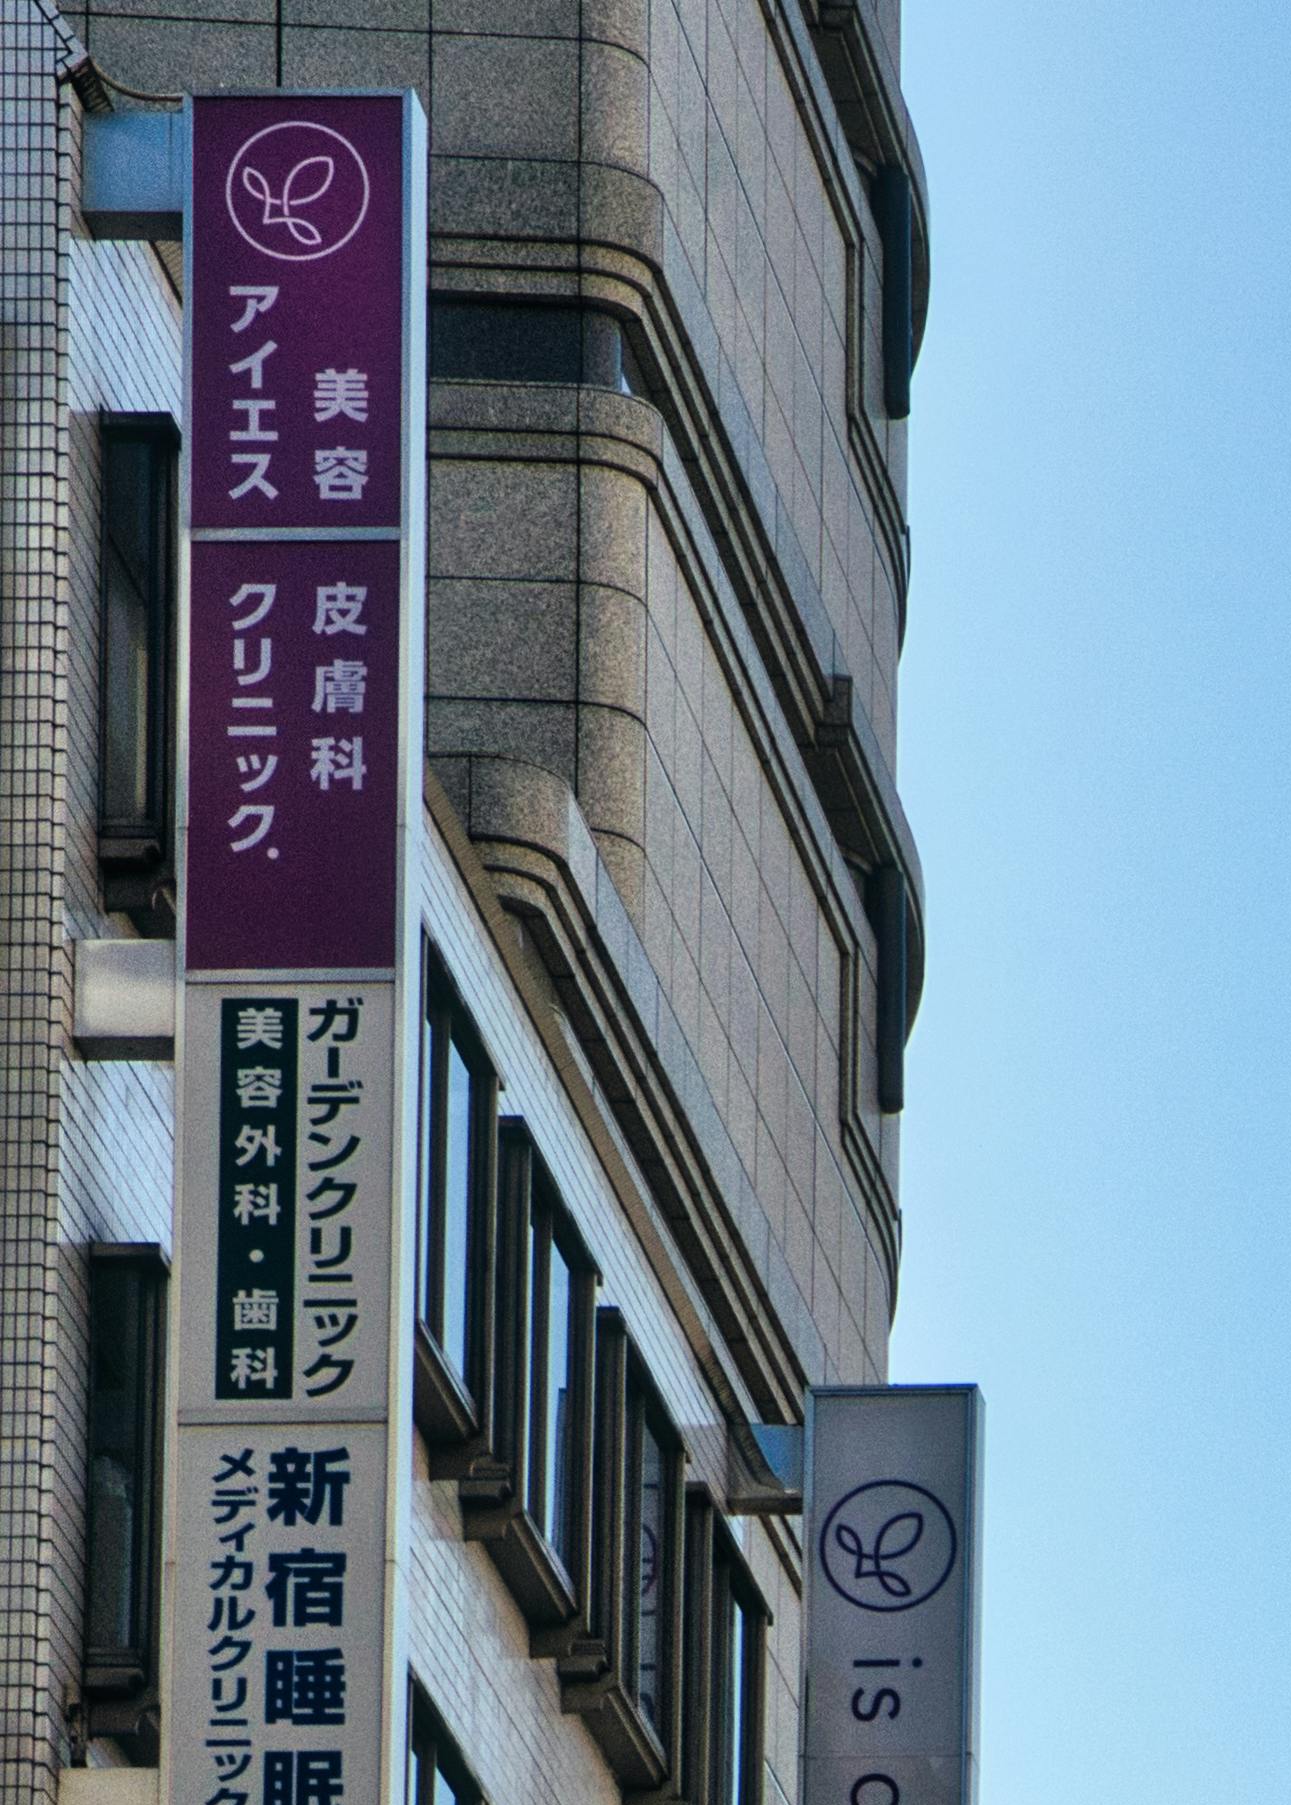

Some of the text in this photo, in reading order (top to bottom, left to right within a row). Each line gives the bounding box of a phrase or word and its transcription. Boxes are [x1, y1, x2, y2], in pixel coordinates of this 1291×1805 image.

[226, 284, 280, 501] アイエス
[311, 368, 370, 791] 美容 皮膚科
[232, 1008, 283, 1390] 美容外科・歯科
[303, 998, 365, 1399] ガーデンクリニック
[852, 1656, 923, 1723] is
